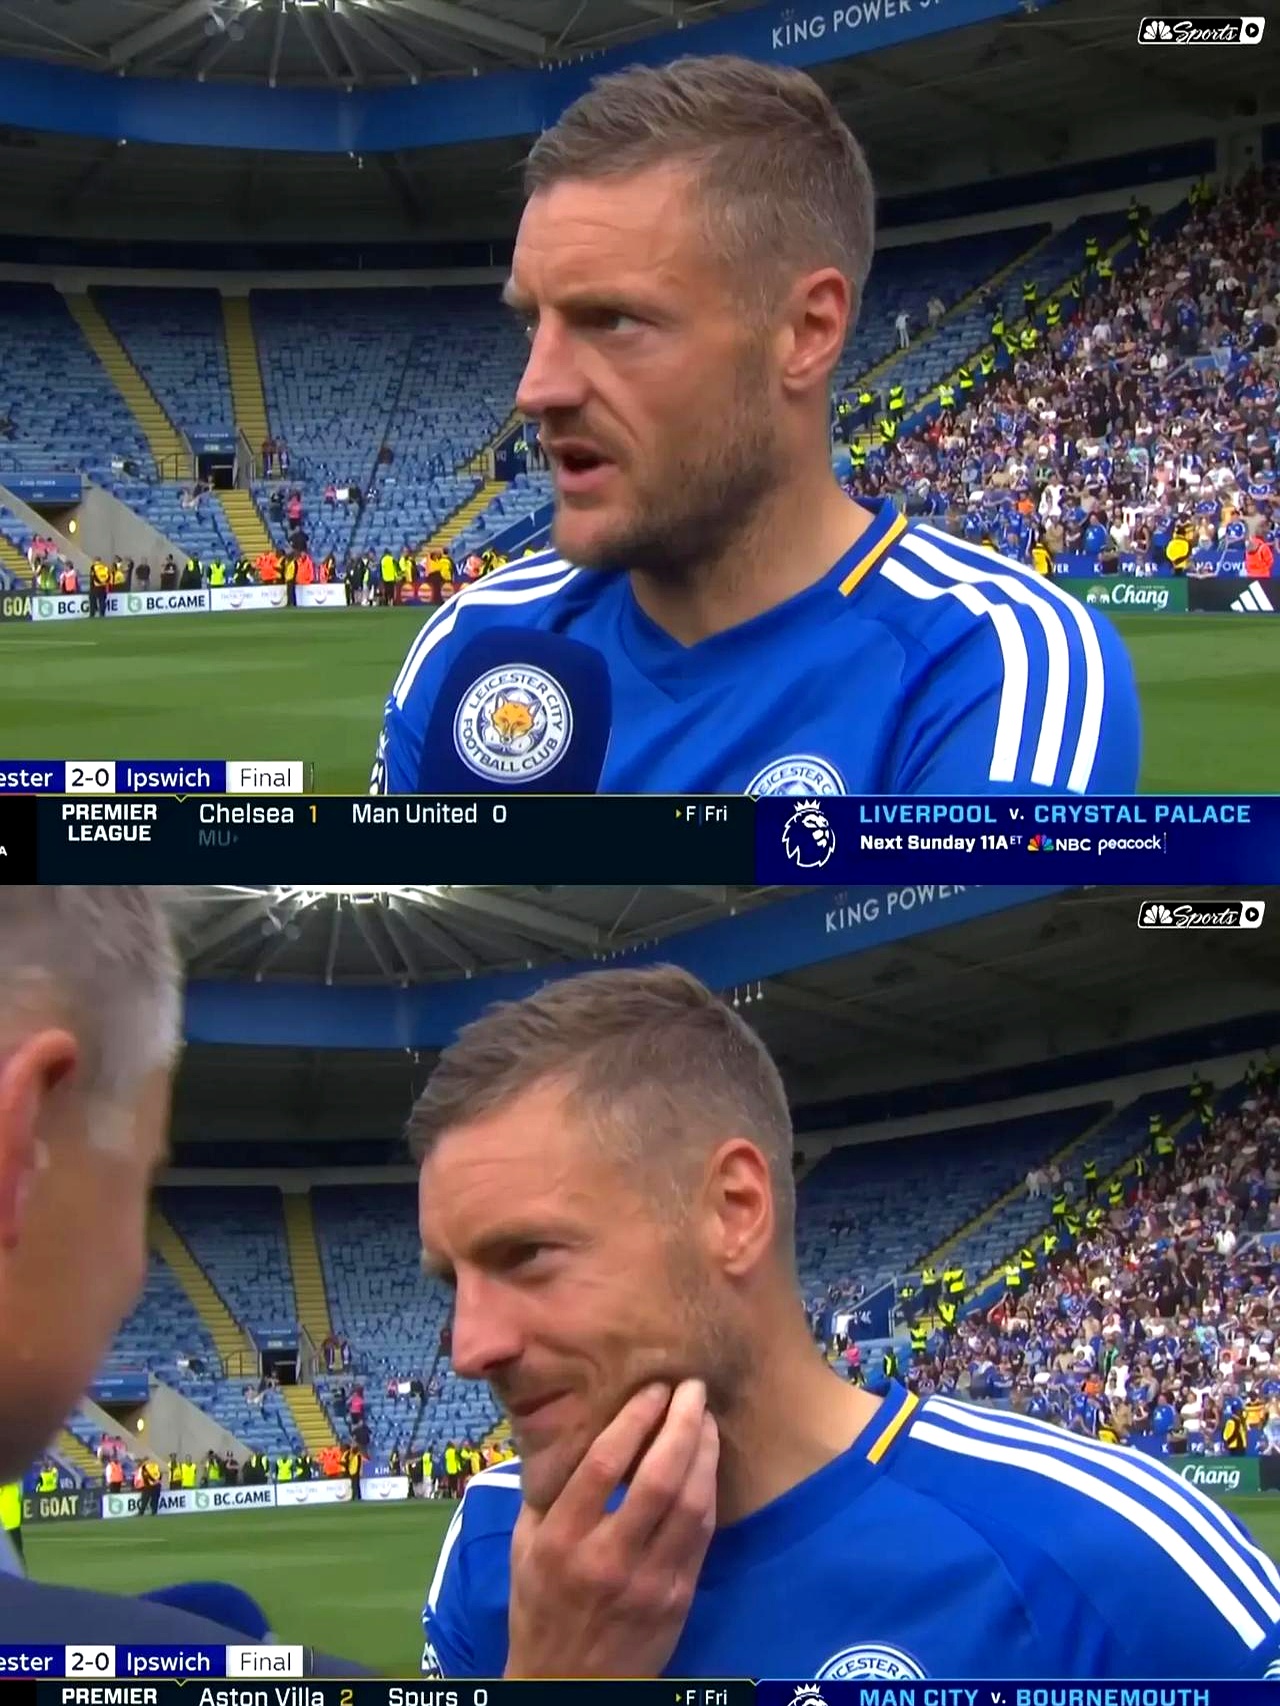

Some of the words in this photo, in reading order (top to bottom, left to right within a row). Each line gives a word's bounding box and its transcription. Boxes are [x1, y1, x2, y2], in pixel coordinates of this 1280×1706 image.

[772, 16, 826, 49] KING
[833, 0, 912, 33] POWER
[146, 594, 206, 610] BC.GAME
[1111, 583, 1169, 609] Chang
[469, 672, 549, 709] LEICESTER
[546, 694, 563, 733] CITY
[463, 718, 520, 773] FOOTBALL
[521, 737, 559, 770] CLUB
[826, 898, 880, 933] KING
[1181, 1463, 1240, 1490] Chang
[39, 1495, 80, 1517] GOAT
[213, 1489, 272, 1506] BC.GAME
